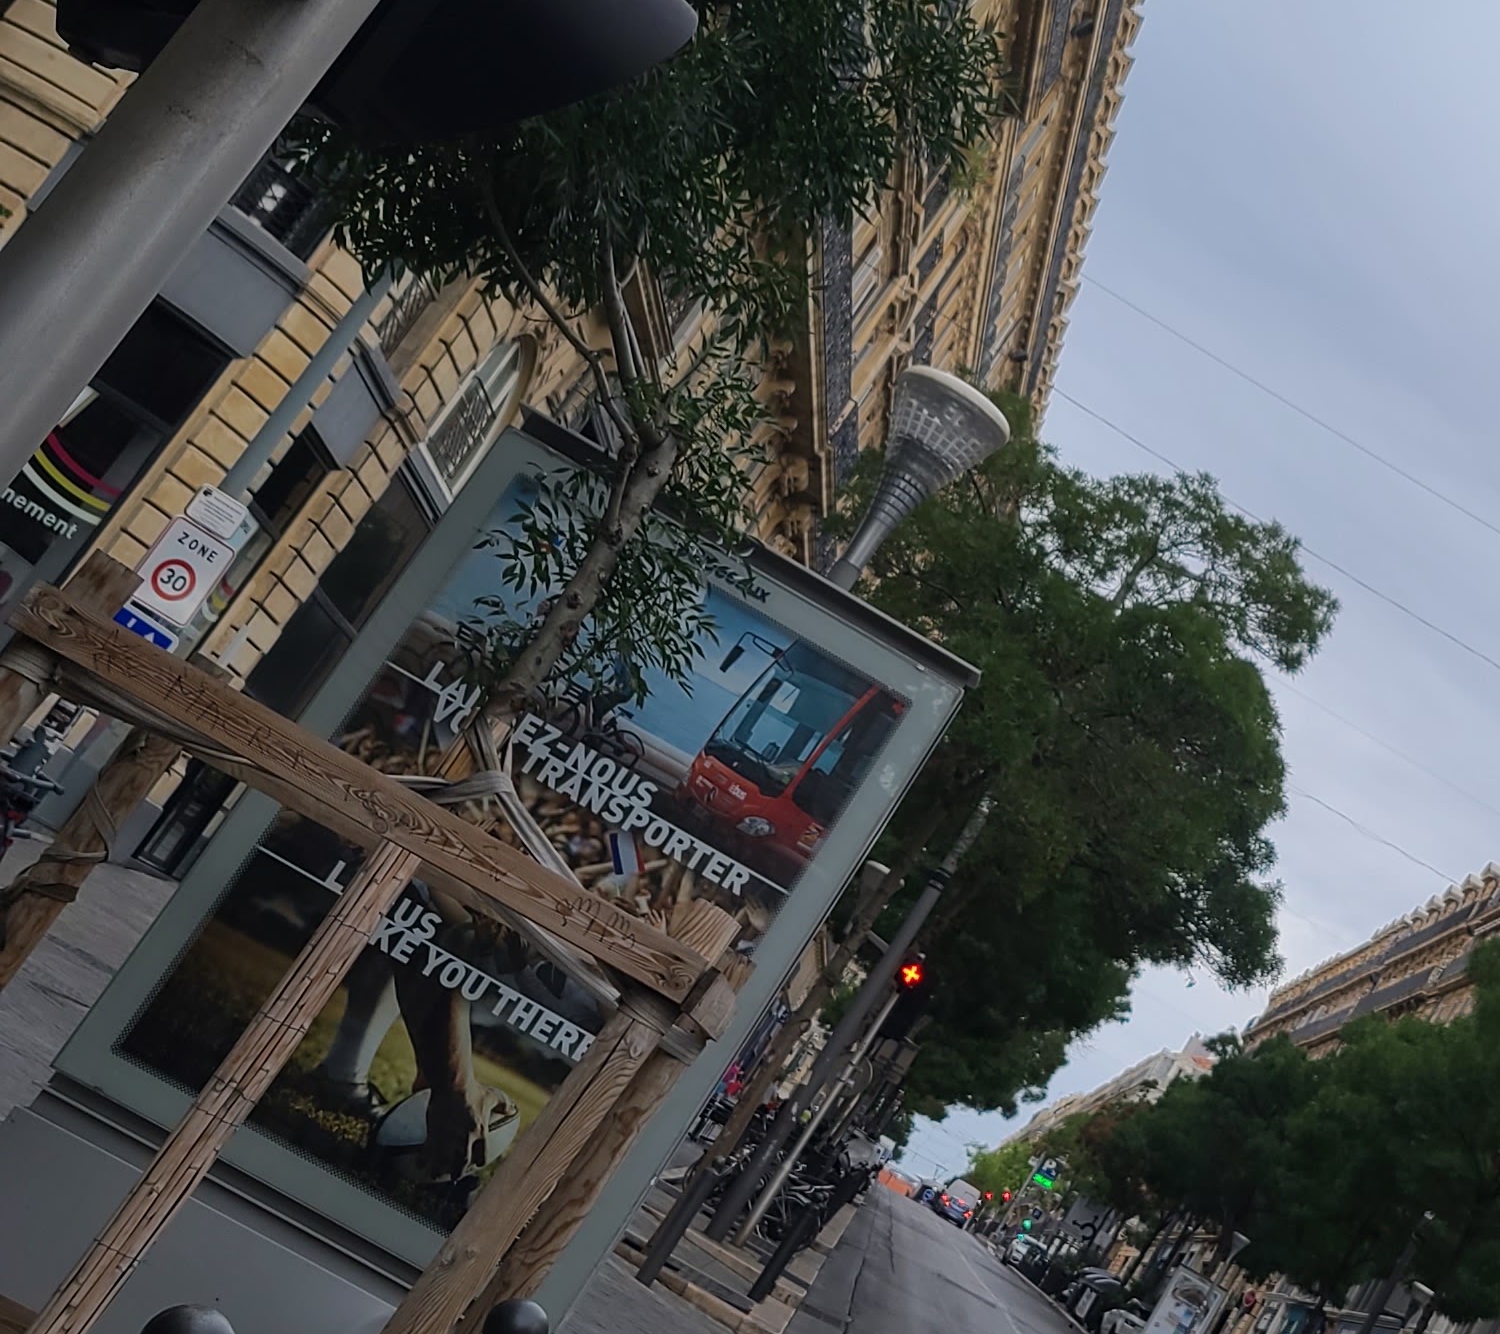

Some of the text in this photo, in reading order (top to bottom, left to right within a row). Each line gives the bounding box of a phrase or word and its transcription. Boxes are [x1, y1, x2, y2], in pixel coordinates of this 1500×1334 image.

[1, 487, 78, 540] nement
[177, 531, 219, 563] ZONE
[160, 568, 187, 592] 30
[424, 660, 658, 809] LAIEZ-NOUS
[521, 742, 750, 896] TRANSPORTER
[393, 898, 443, 941] US
[368, 917, 421, 964] KE
[422, 944, 492, 1001] YOU
